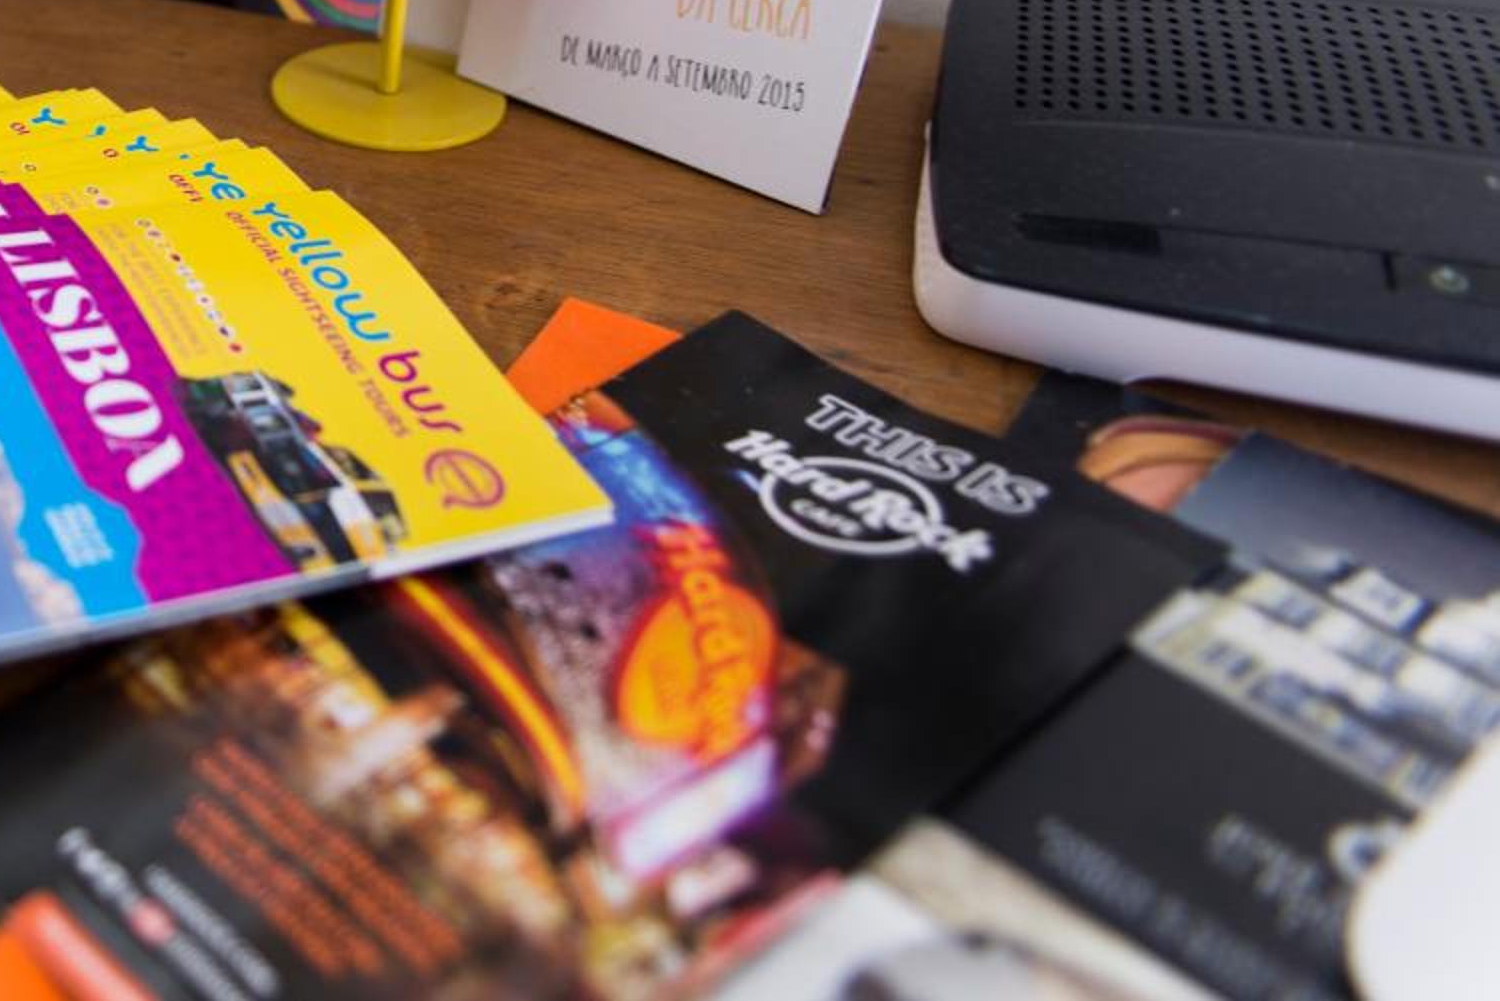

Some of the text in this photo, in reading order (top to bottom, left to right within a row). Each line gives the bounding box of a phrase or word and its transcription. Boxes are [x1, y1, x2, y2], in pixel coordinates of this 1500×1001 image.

[561, 34, 808, 113] DE MARÇO A SETEMBRO 2015
[226, 209, 414, 440] OFFICIAL SIGHTSEEING TOURS
[251, 201, 463, 434] Yellow bus
[723, 429, 996, 575] Hard Rock
[804, 393, 1051, 517] THIS IS
